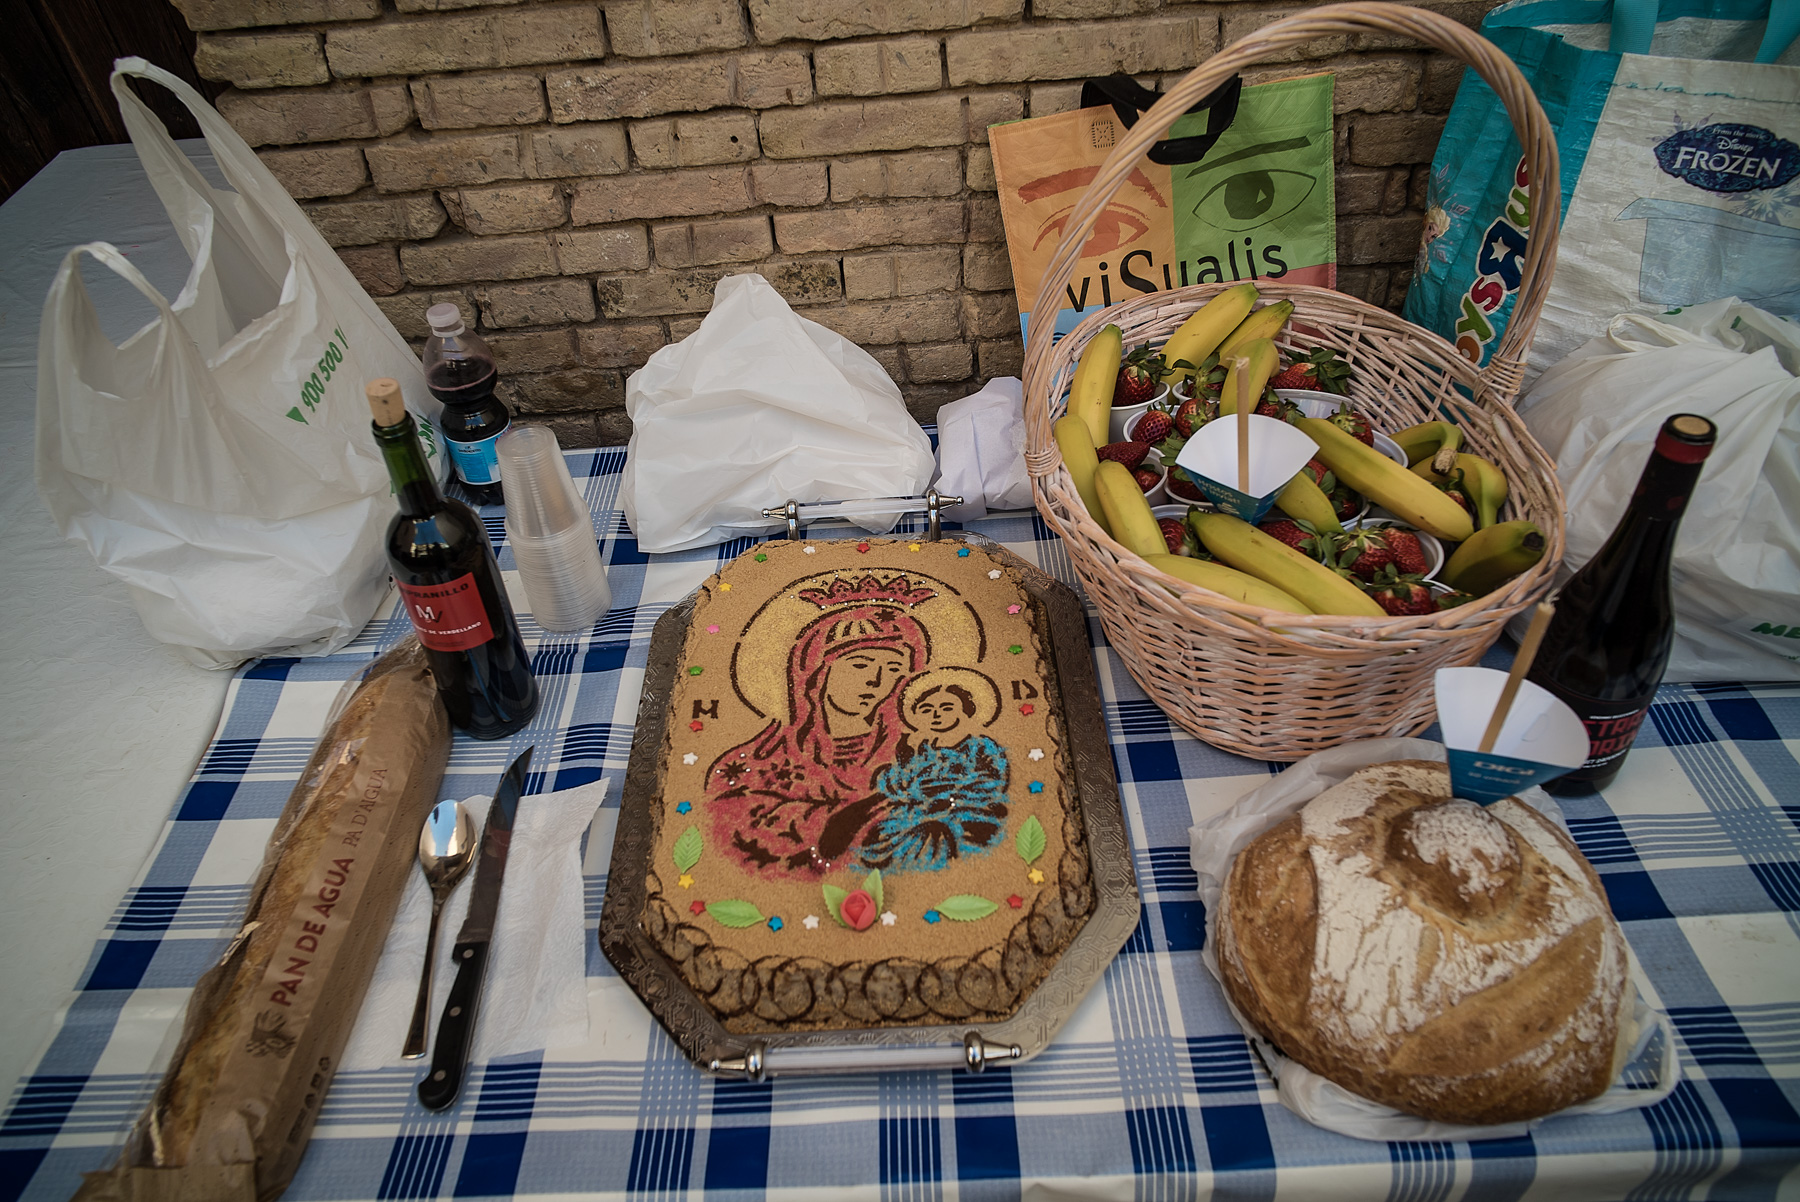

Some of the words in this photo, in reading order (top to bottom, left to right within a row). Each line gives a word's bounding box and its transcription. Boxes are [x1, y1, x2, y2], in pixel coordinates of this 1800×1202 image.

[1672, 146, 1782, 180] FROZEN
[1716, 135, 1754, 155] Disney
[1456, 276, 1504, 365] OYS
[301, 372, 326, 413] 900
[318, 341, 343, 382] 500
[351, 768, 388, 827] D'AIGUA
[342, 830, 363, 848] PA
[312, 858, 355, 918] AGUA
[295, 920, 327, 954] DE
[269, 956, 311, 1007] PAN
